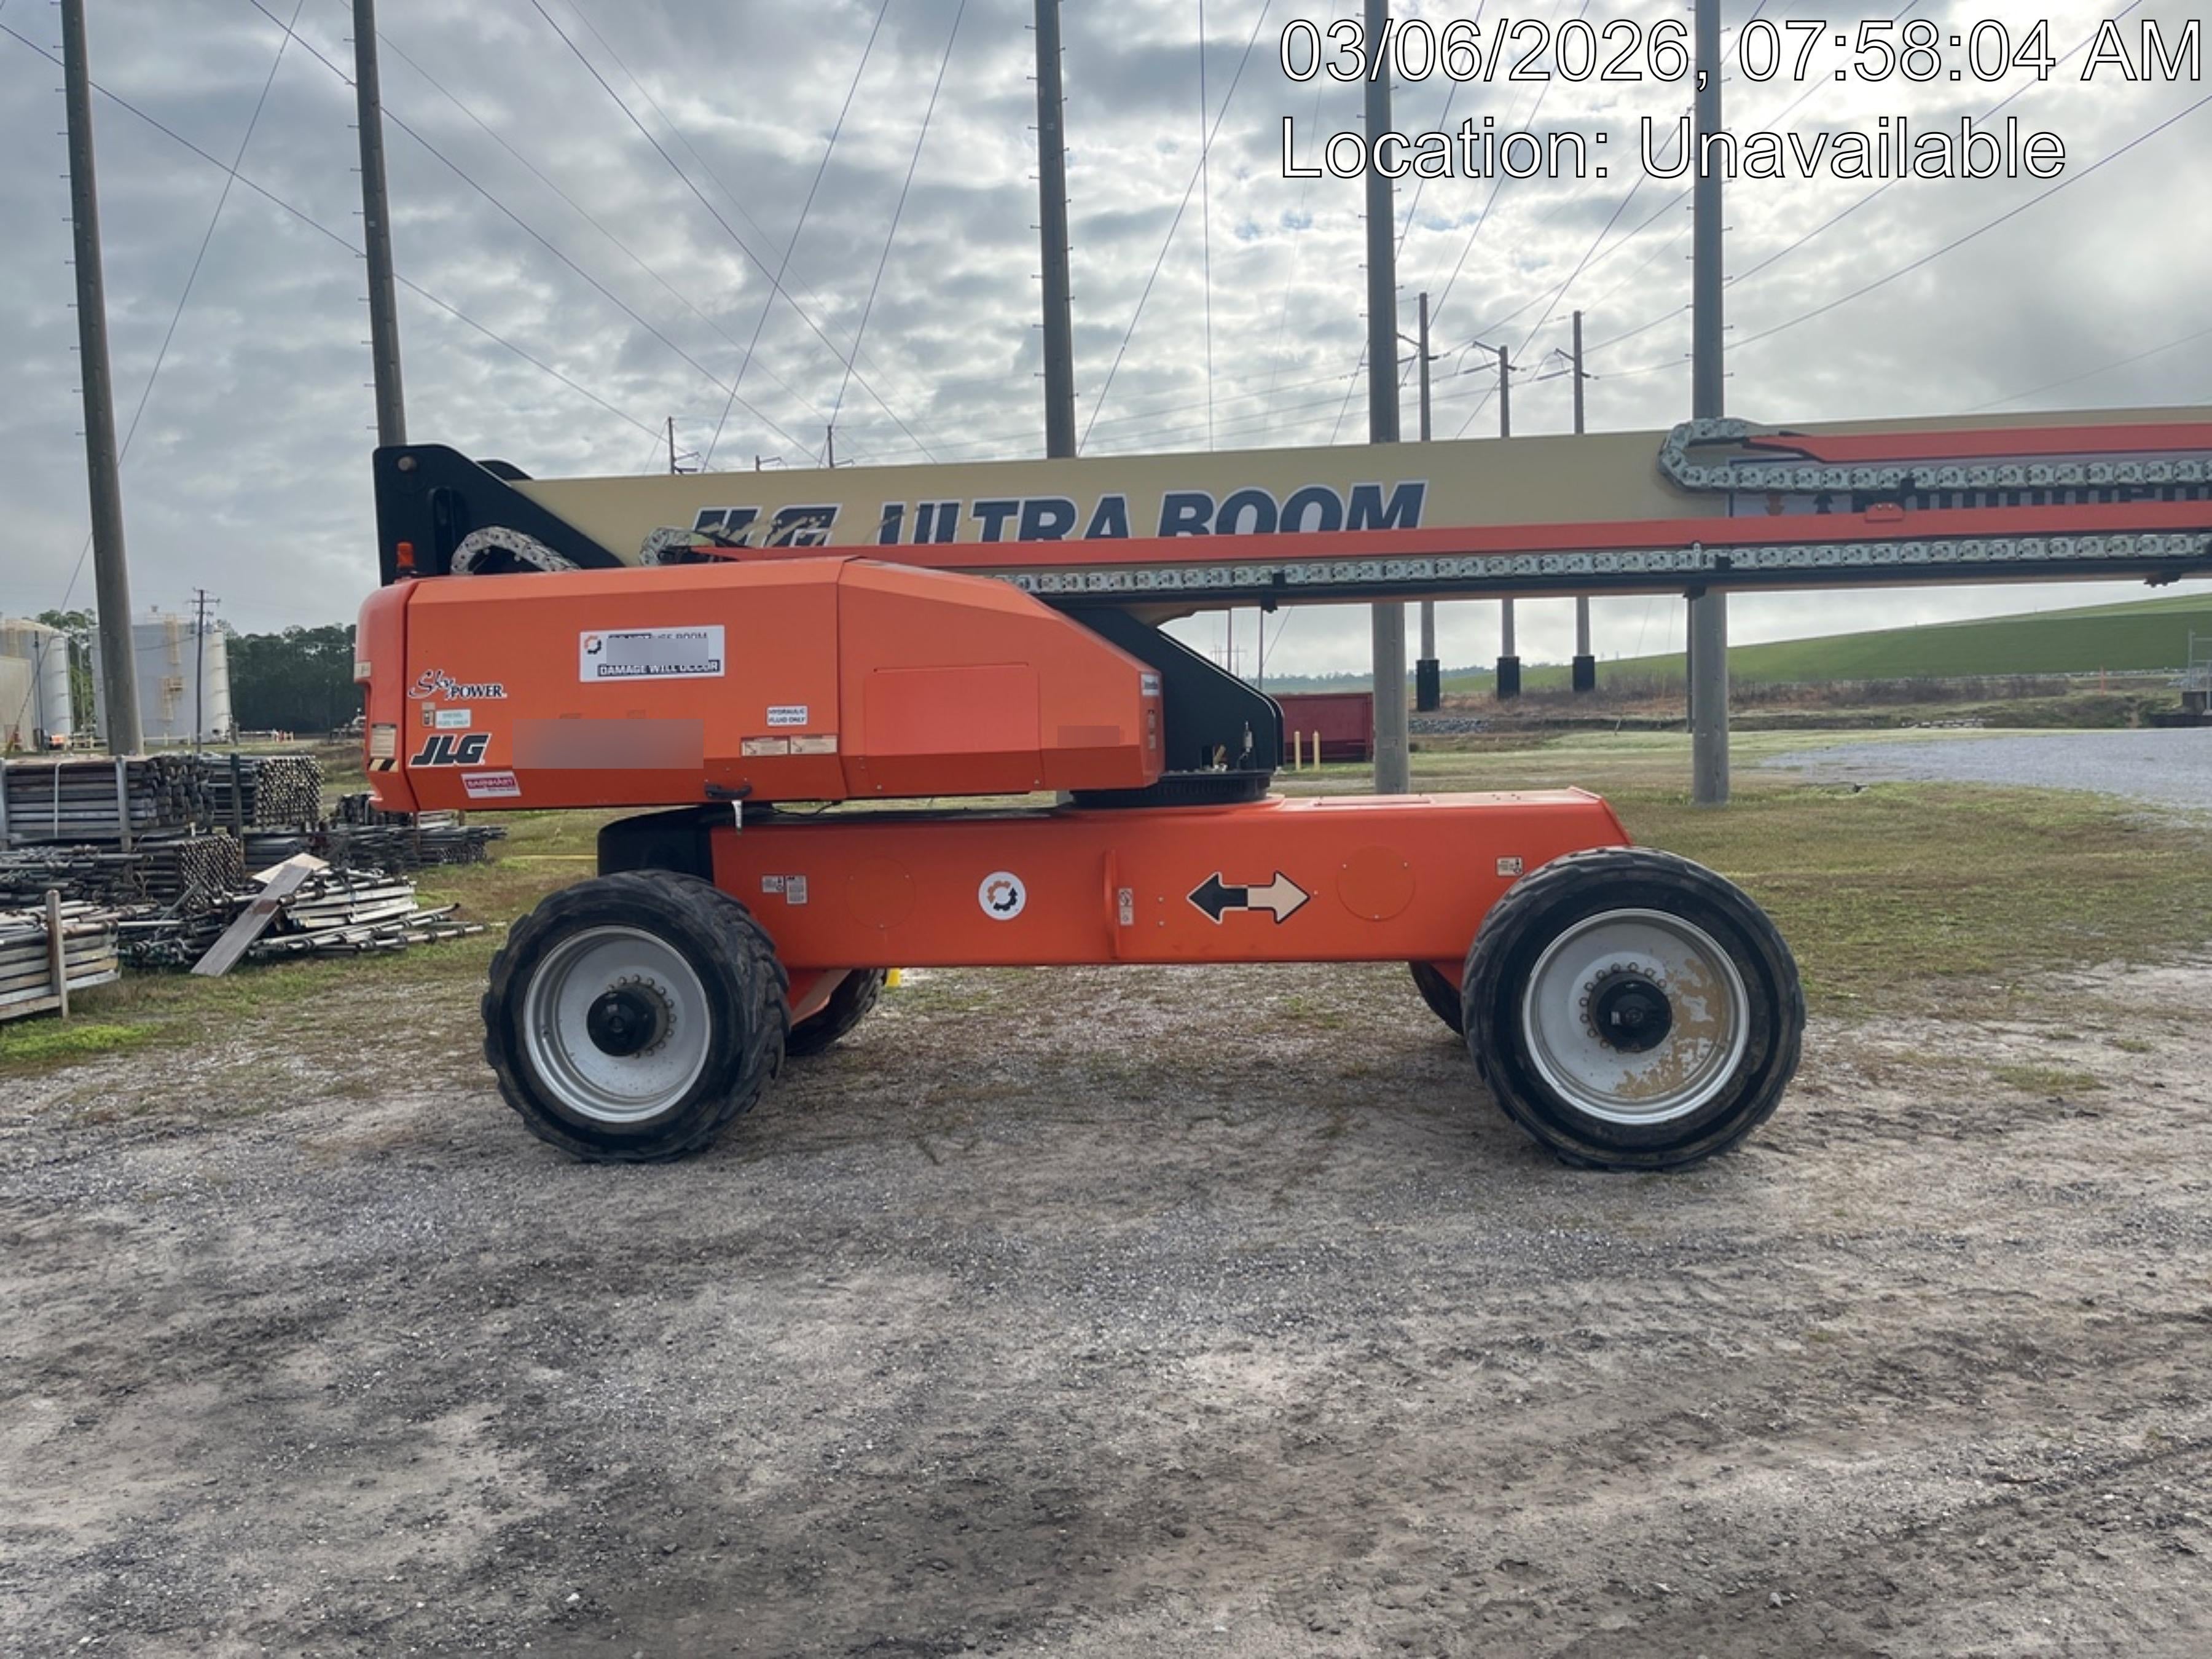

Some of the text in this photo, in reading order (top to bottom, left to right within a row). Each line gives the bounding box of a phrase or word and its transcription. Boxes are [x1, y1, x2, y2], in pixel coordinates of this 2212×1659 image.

[1157, 480, 1429, 538] BOOM
[450, 684, 503, 699] POWER
[410, 734, 491, 767] JLG
